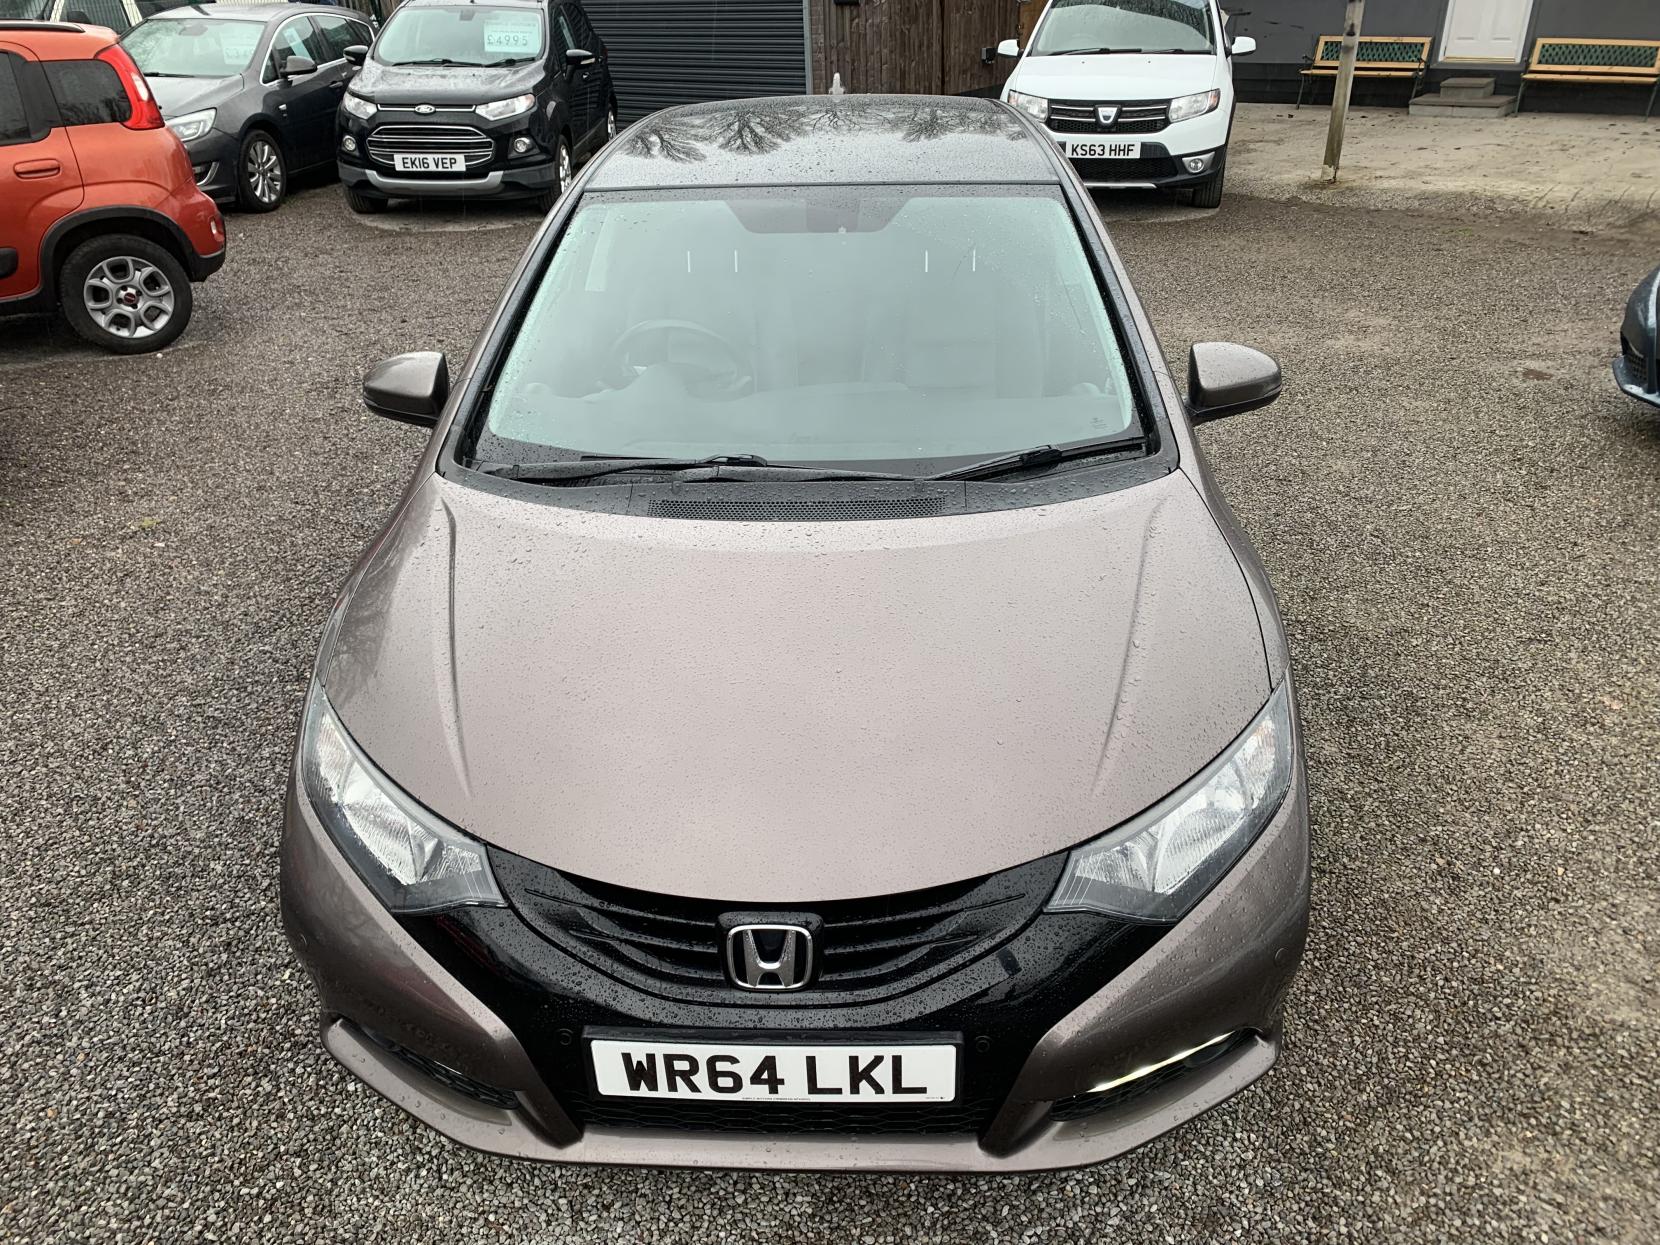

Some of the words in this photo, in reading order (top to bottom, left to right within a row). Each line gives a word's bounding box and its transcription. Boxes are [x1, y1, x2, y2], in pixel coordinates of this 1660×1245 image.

[487, 34, 528, 47] £4995
[1071, 144, 1106, 156] KS63
[1109, 144, 1135, 156] HHF
[402, 157, 430, 169] EK16
[433, 157, 457, 169] VEP
[621, 1052, 785, 1095] WR64
[805, 1055, 928, 1095] LKL
